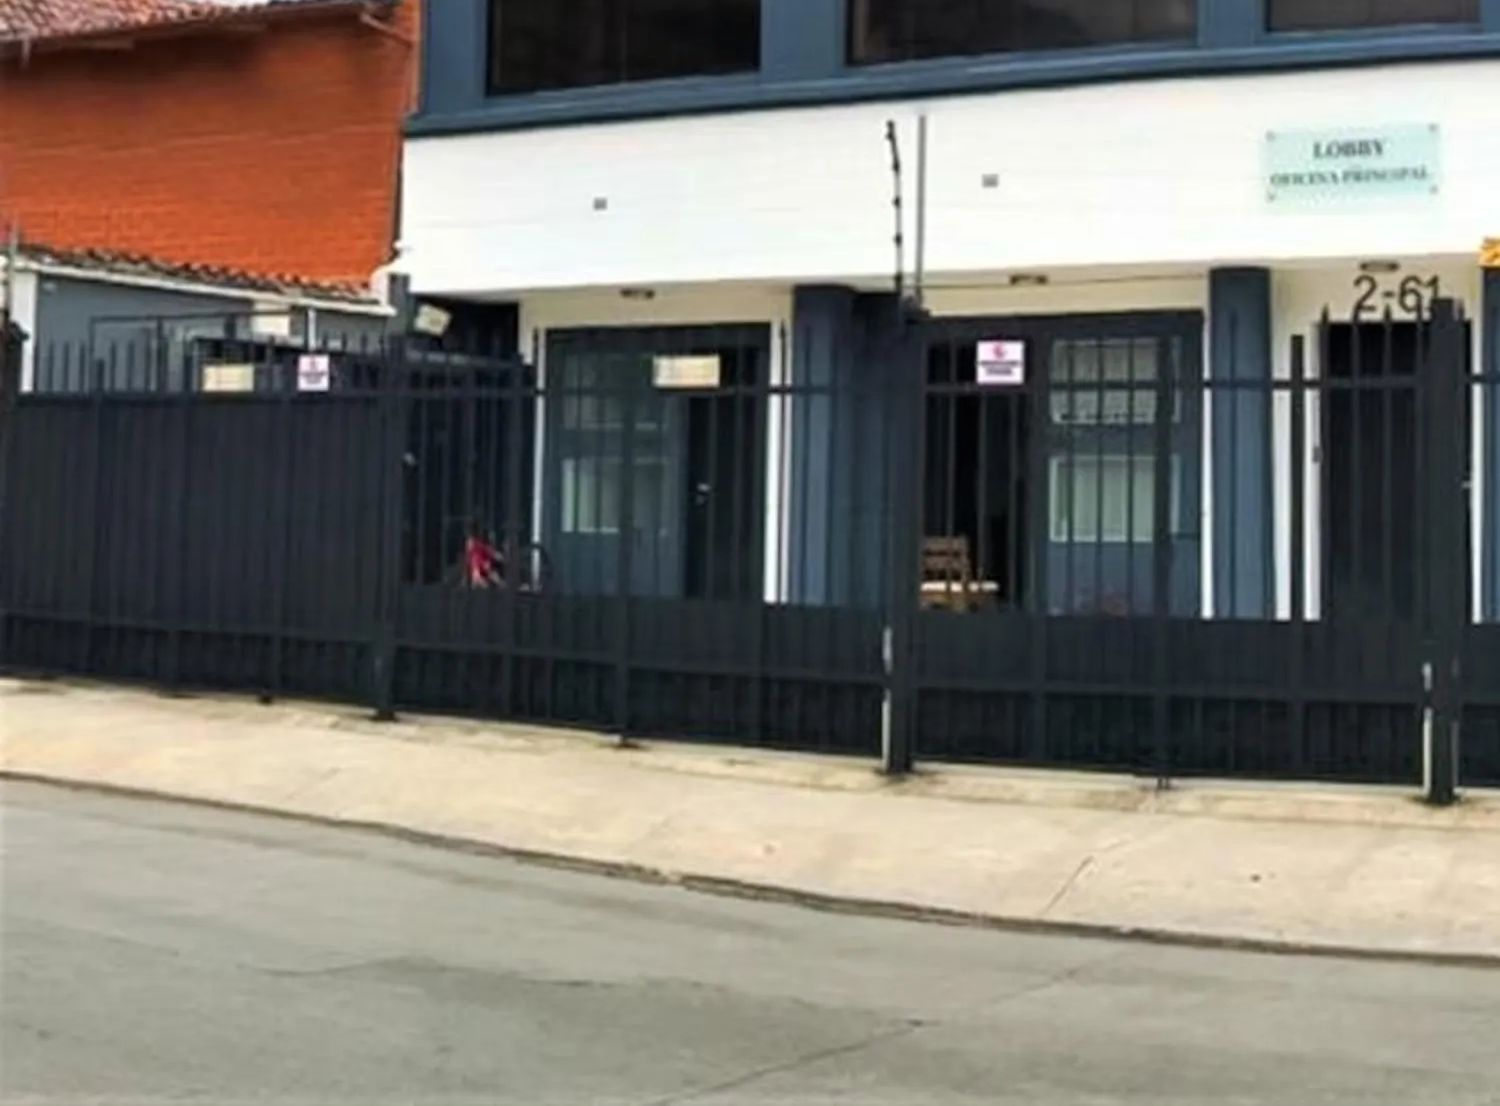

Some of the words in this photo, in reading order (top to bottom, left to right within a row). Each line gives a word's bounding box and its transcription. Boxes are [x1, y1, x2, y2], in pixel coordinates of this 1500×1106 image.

[1312, 139, 1385, 159] LOBBY
[1342, 164, 1428, 183] PRINCIPAL
[1353, 274, 1440, 312] 2-61
